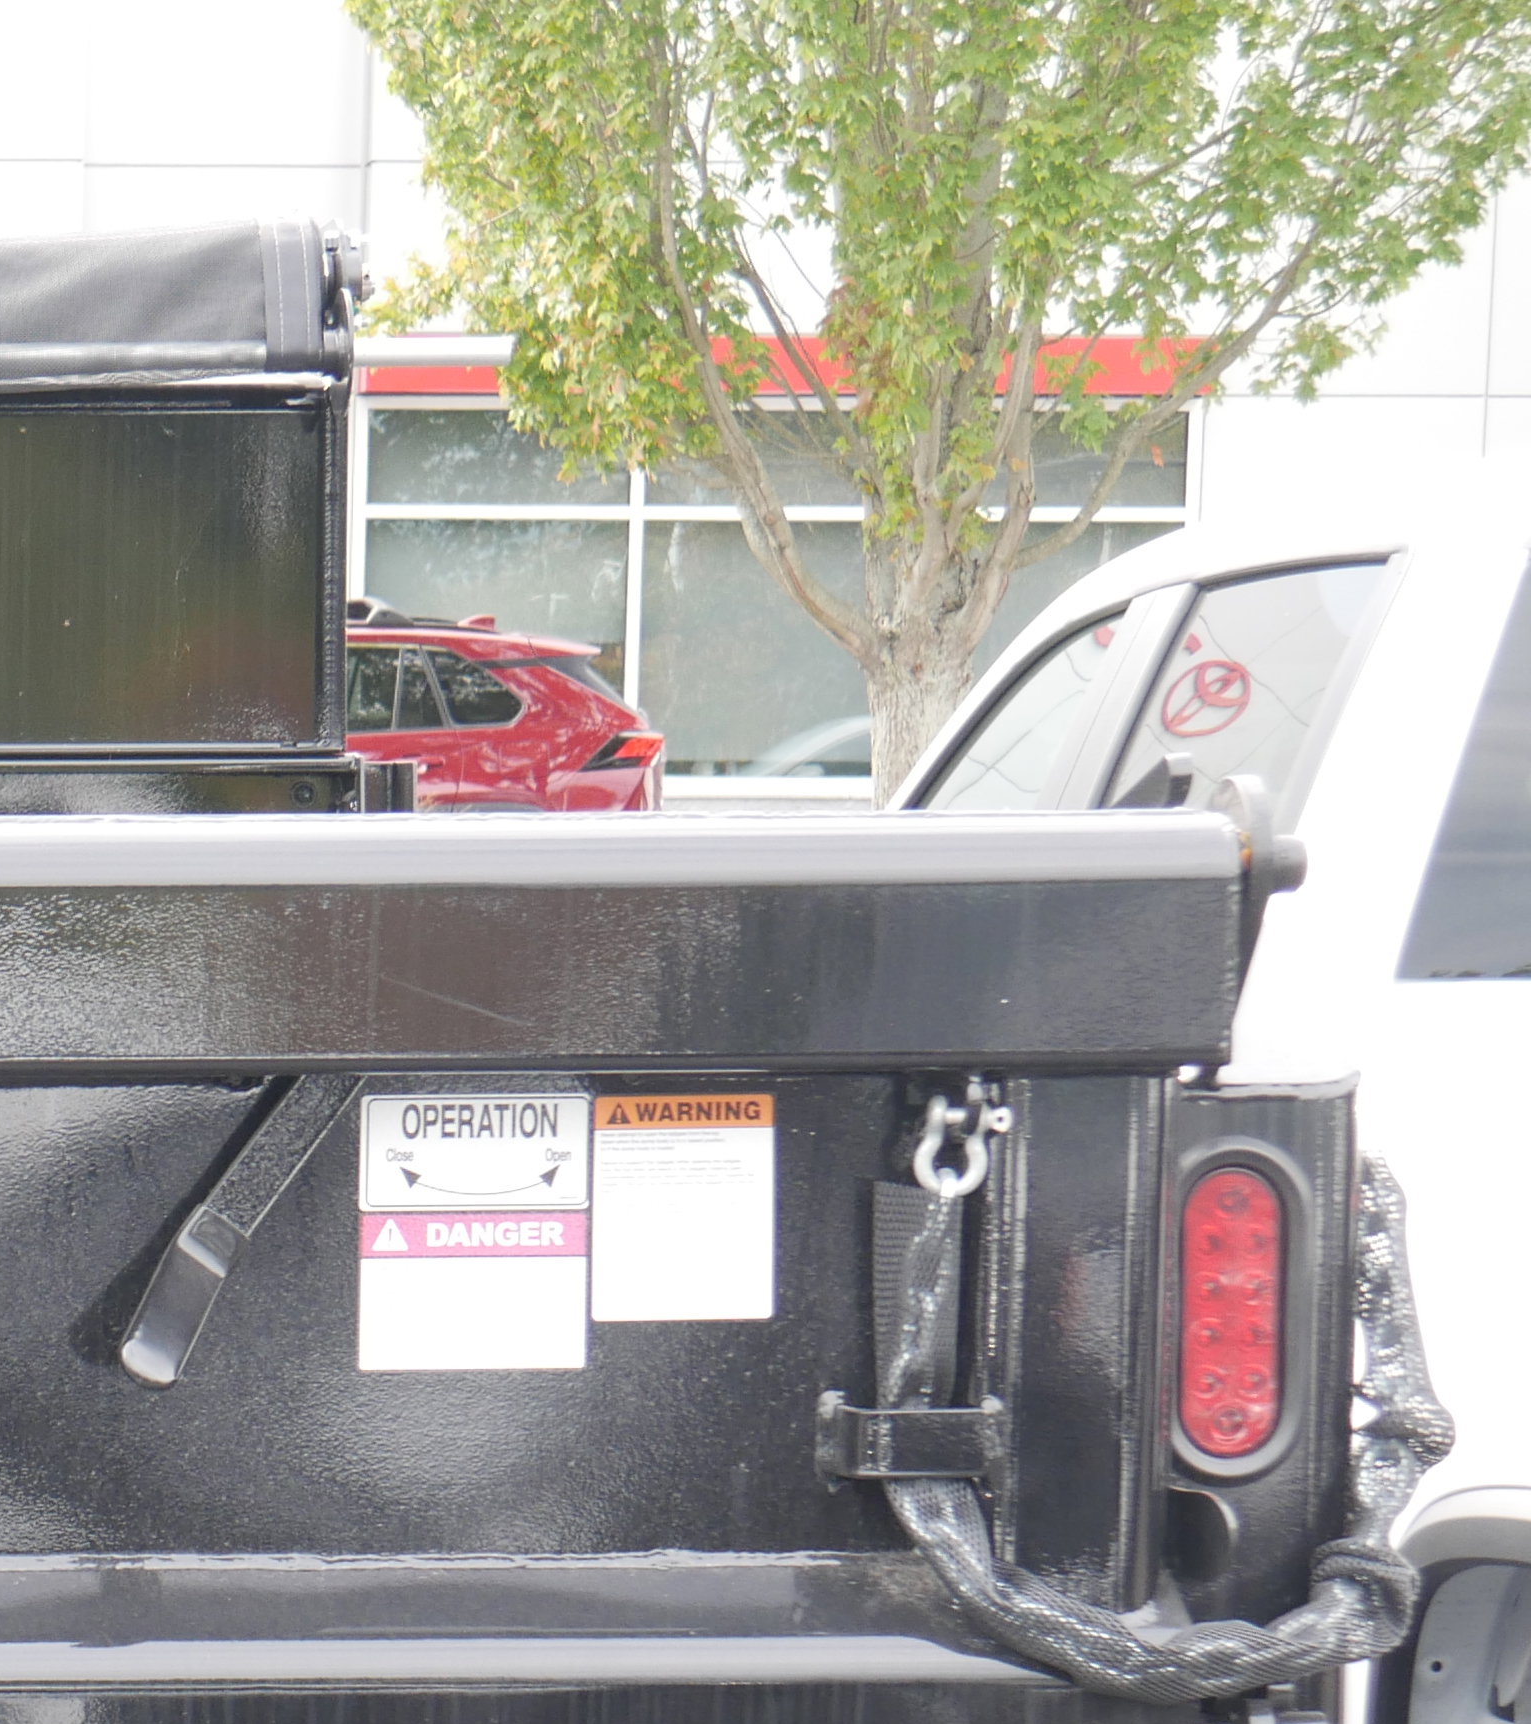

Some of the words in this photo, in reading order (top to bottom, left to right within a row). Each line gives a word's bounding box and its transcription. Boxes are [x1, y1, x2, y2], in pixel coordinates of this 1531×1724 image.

[401, 1102, 559, 1140] OPERATION
[636, 1100, 762, 1122] WARNING
[385, 1147, 415, 1163] Close
[544, 1147, 572, 1165] Open
[426, 1220, 565, 1249] DANGER
